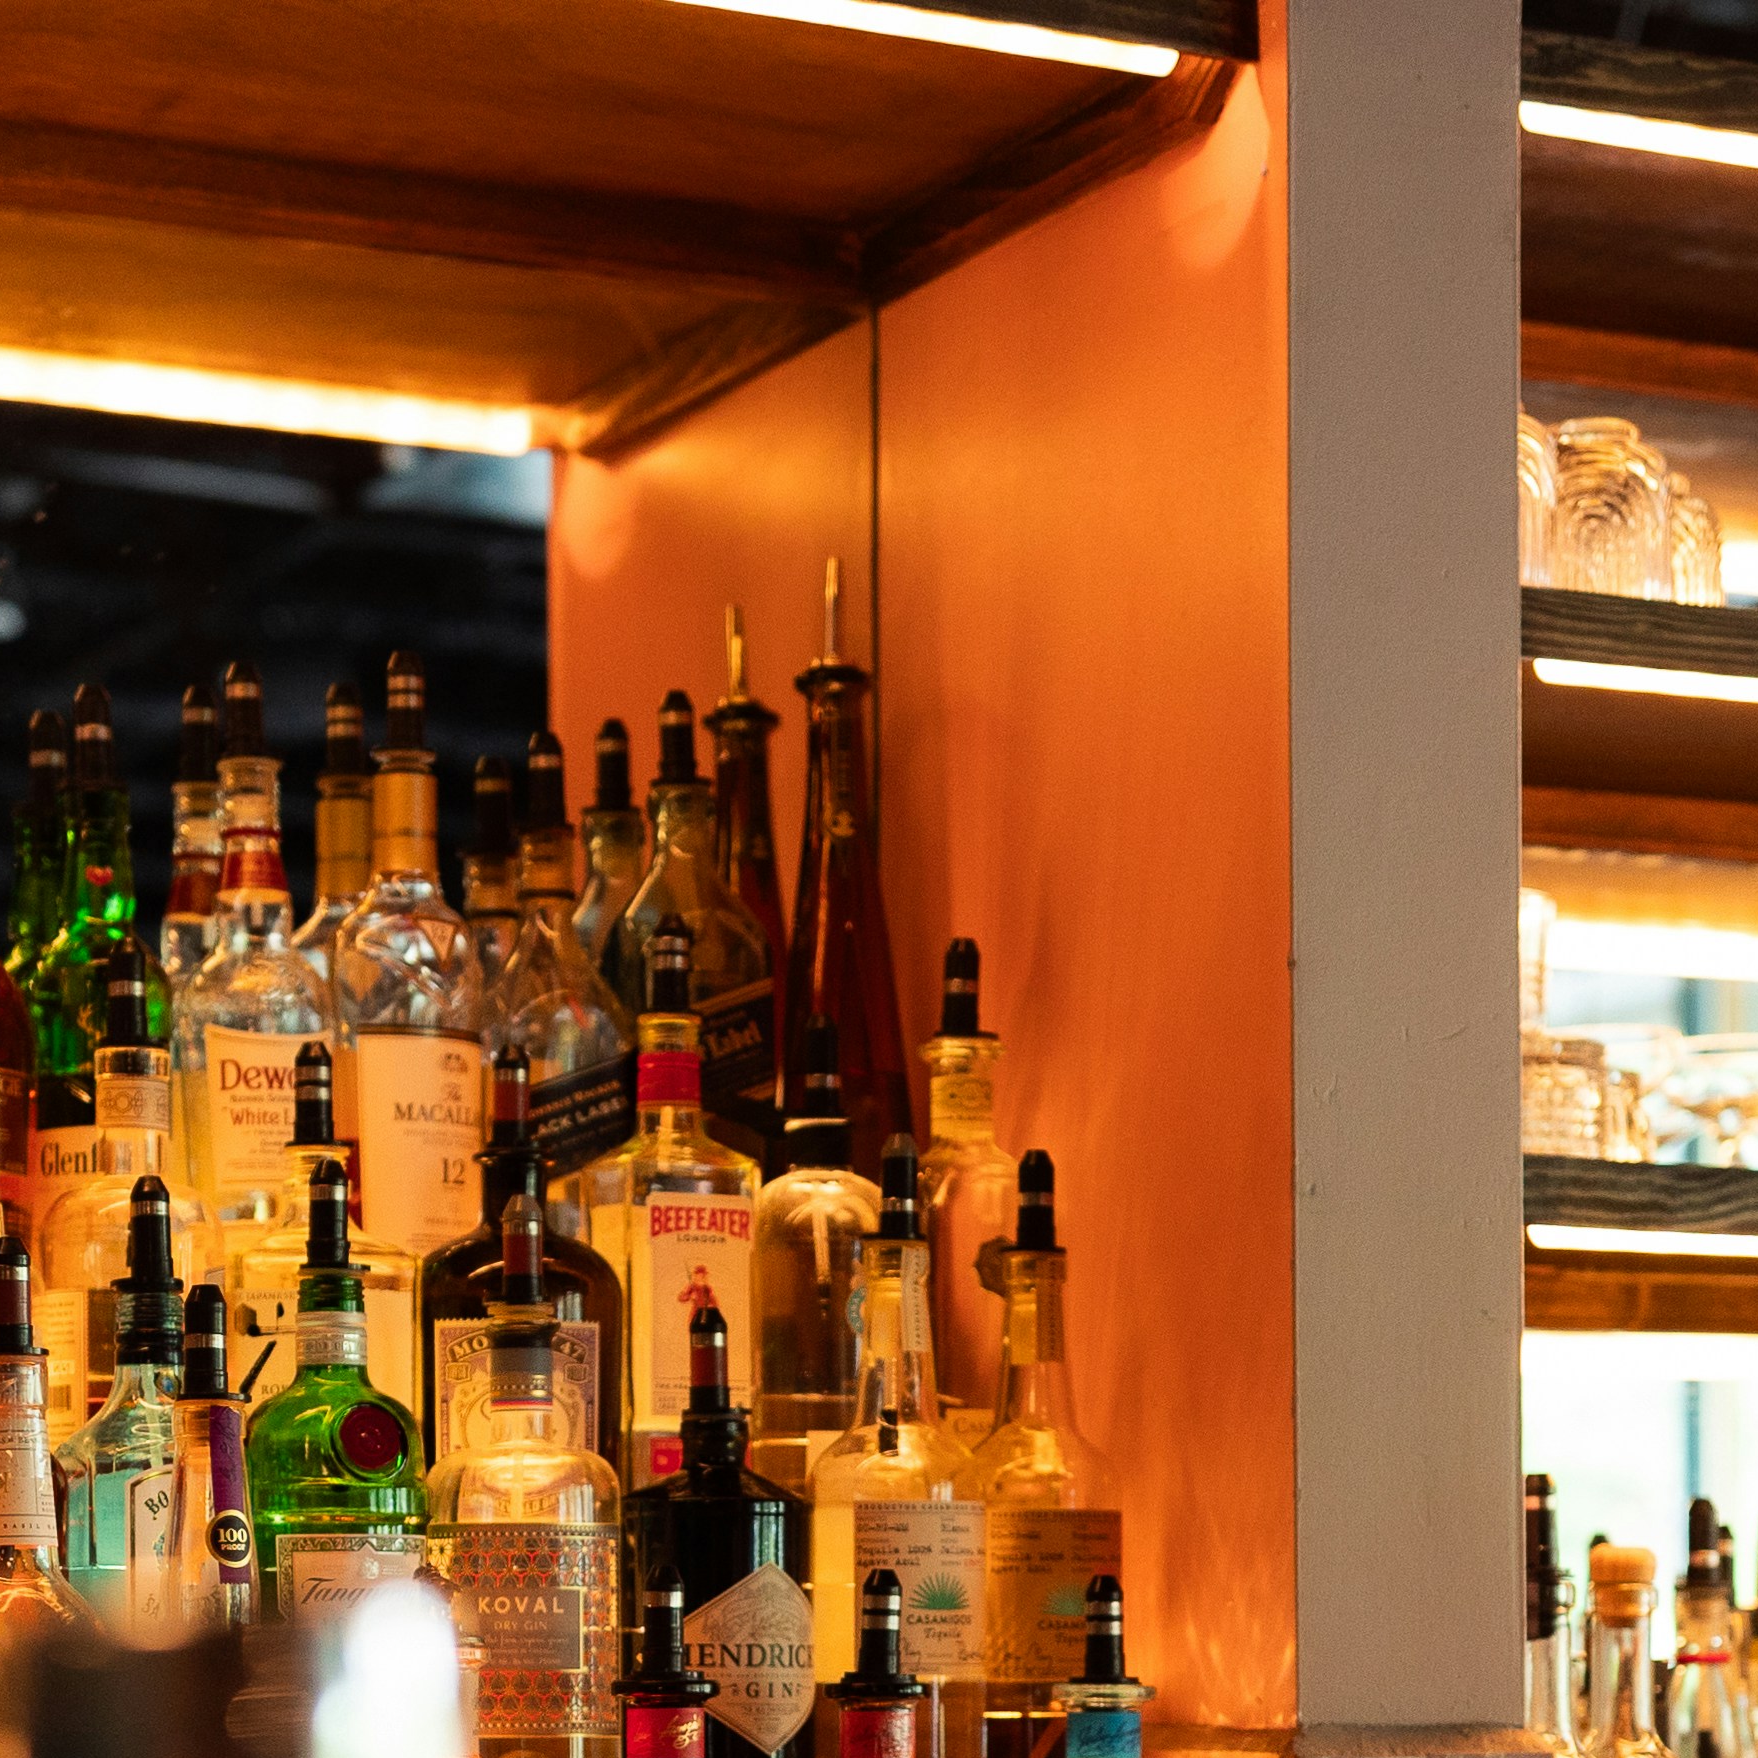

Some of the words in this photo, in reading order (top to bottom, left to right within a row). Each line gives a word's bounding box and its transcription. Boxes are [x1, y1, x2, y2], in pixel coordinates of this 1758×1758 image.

[442, 1157, 465, 1184] 12
[650, 1205, 750, 1241] BEEFEATER
[676, 1233, 727, 1244] LONDON
[218, 1528, 247, 1543] 100
[221, 1543, 246, 1551] PROOF
[478, 1596, 564, 1614] KOVAL
[493, 1621, 518, 1631] DRY
[524, 1621, 547, 1631] GIN
[906, 1614, 971, 1626] CASAMIGOS
[745, 1681, 793, 1699] GIN
